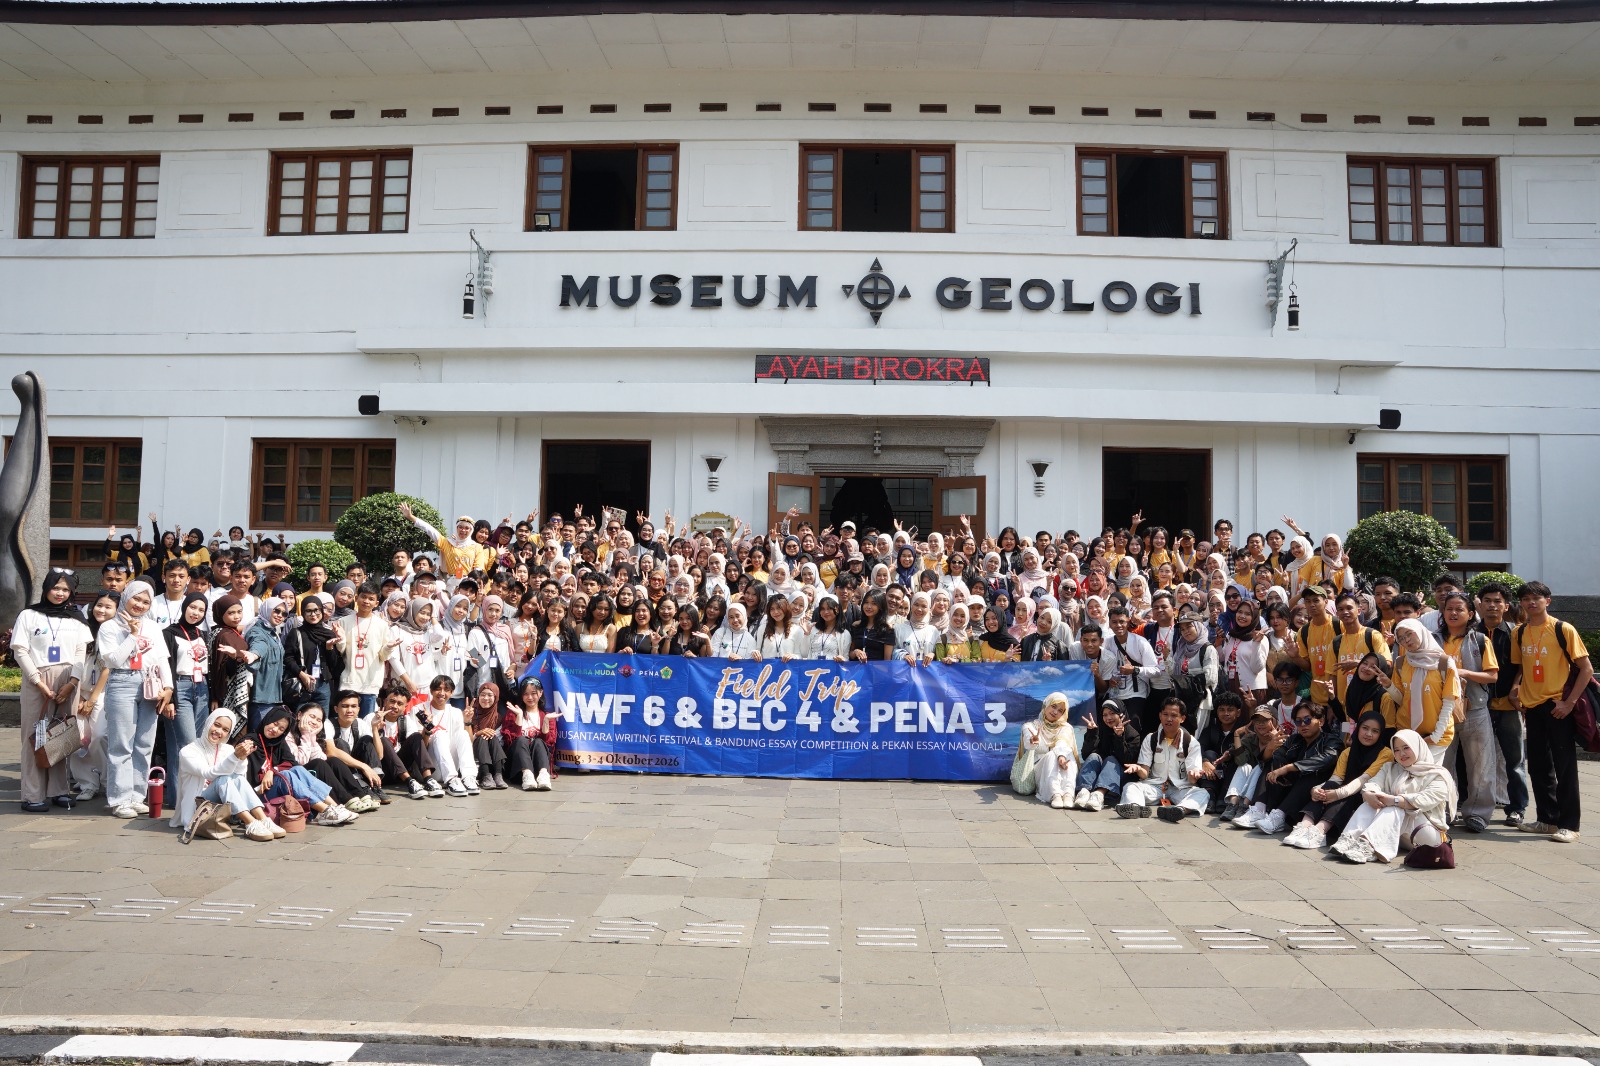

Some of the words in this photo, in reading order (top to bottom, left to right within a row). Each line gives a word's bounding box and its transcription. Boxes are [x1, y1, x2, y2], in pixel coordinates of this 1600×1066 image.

[558, 273, 818, 308] MUSEUM
[936, 276, 1202, 315] GEOLOGI
[853, 356, 986, 381] BIROKRA
[715, 663, 792, 702] Field
[798, 667, 862, 711] Trip
[553, 690, 636, 726] NWF
[643, 695, 666, 727] 6
[673, 696, 703, 728] &
[712, 698, 787, 732] BEC
[795, 700, 822, 732] 4
[831, 701, 860, 733] &
[870, 701, 975, 734] PENA
[984, 702, 1007, 734] 3
[605, 752, 653, 766] Oktober
[654, 756, 680, 767] 2026
[614, 733, 657, 744] WRITING
[659, 735, 703, 746] FESTIVAL
[704, 736, 713, 746] &
[715, 737, 766, 748] BANDUNG
[768, 739, 798, 749] ESSAY
[800, 739, 869, 751] COMPETITION
[871, 740, 880, 750] &
[881, 740, 914, 751] PEKAN
[916, 741, 947, 751] ESSAY
[948, 741, 1004, 753] NASIONAL)
